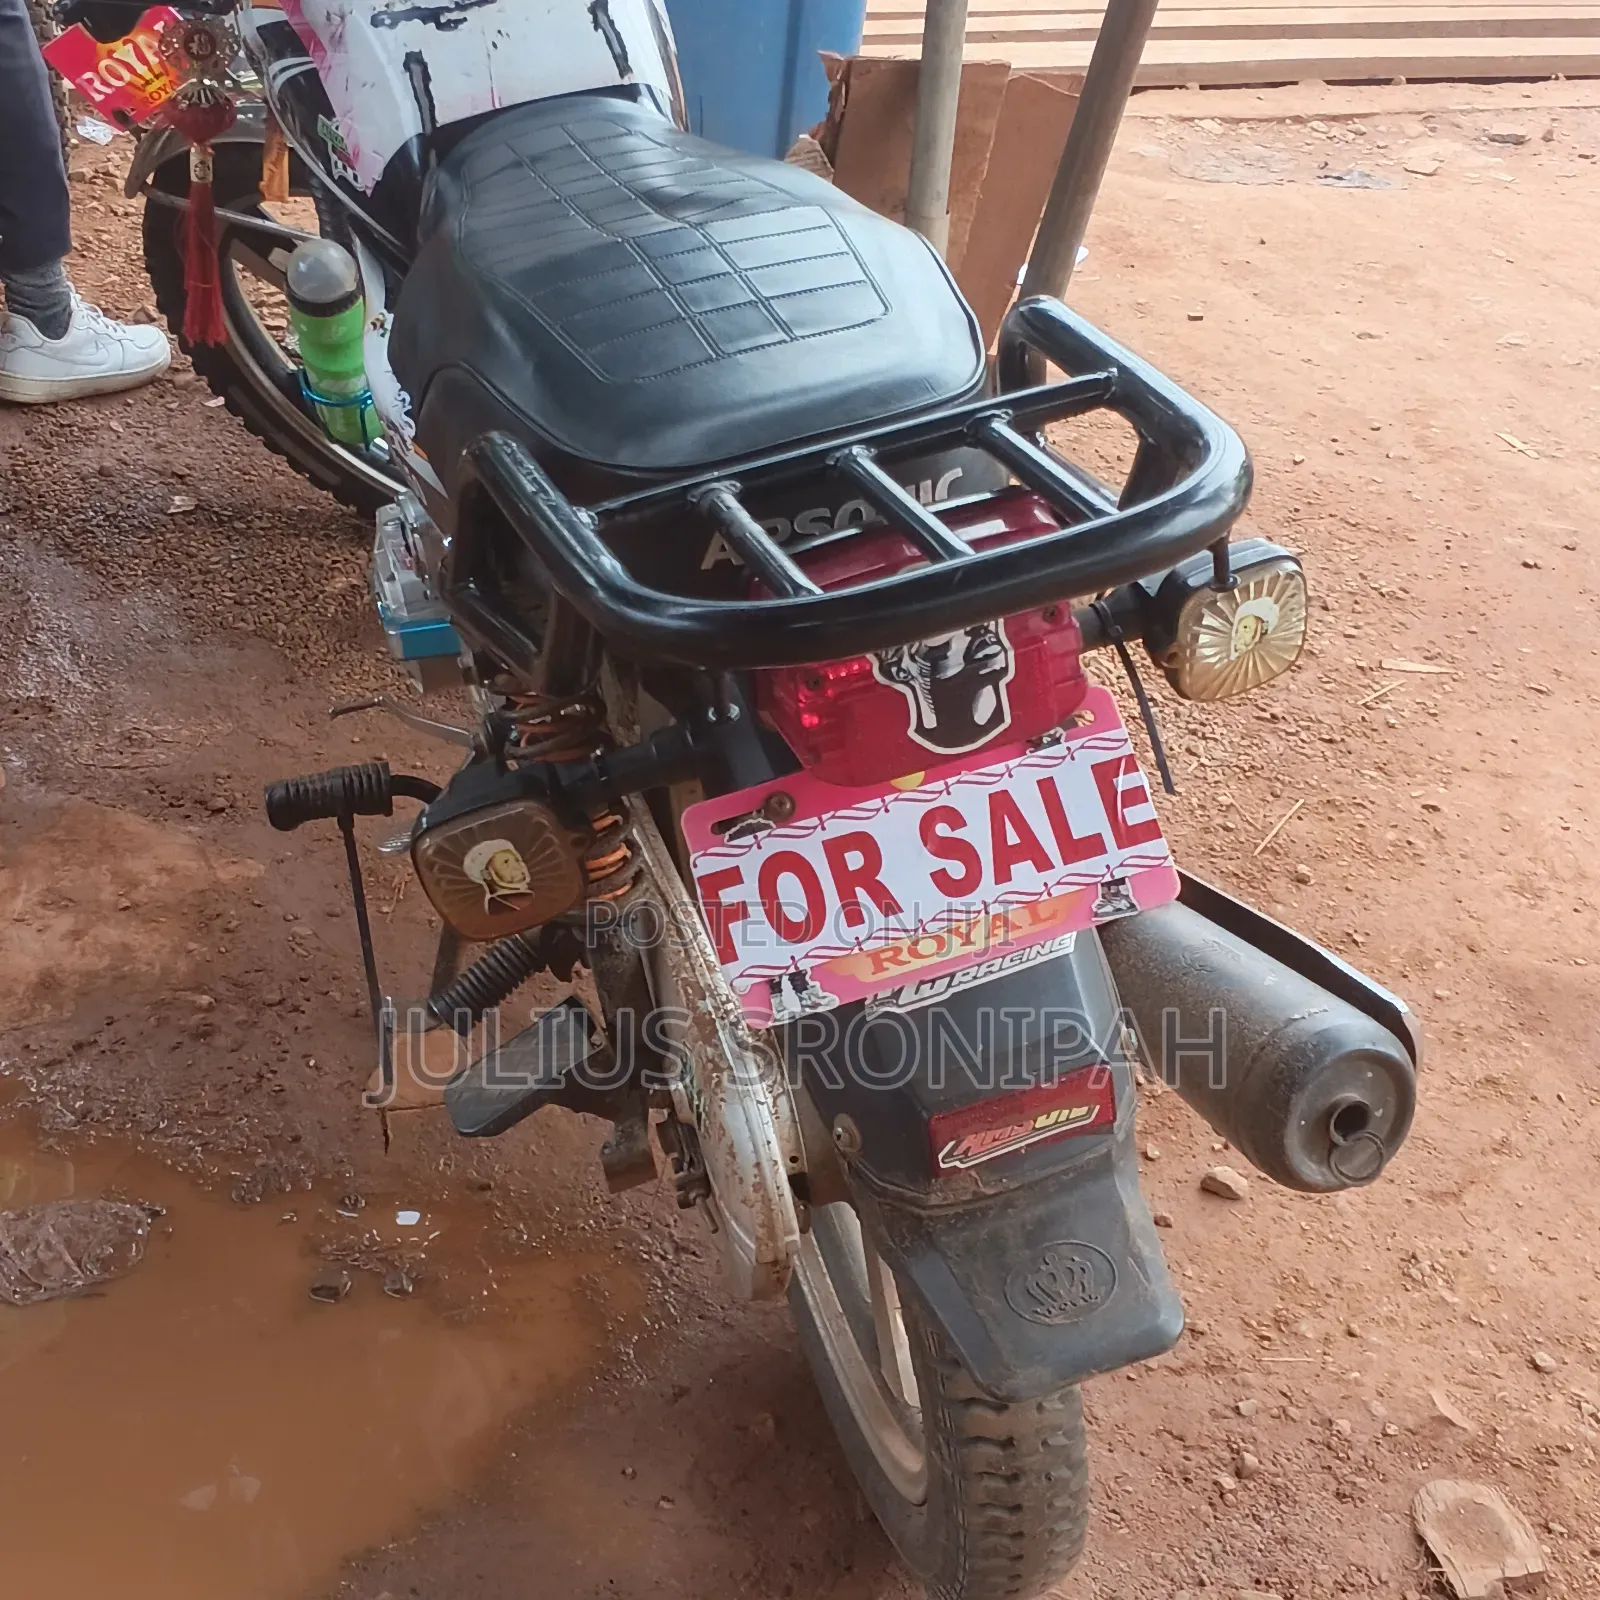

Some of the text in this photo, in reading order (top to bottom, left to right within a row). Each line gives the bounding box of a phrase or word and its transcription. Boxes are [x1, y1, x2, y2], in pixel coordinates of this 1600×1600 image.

[75, 20, 165, 102] ROYA
[146, 79, 178, 106] ROYA
[697, 753, 1164, 966] FOR SALE
[870, 901, 1059, 976] ROYAL
[951, 933, 1074, 987] RACING
